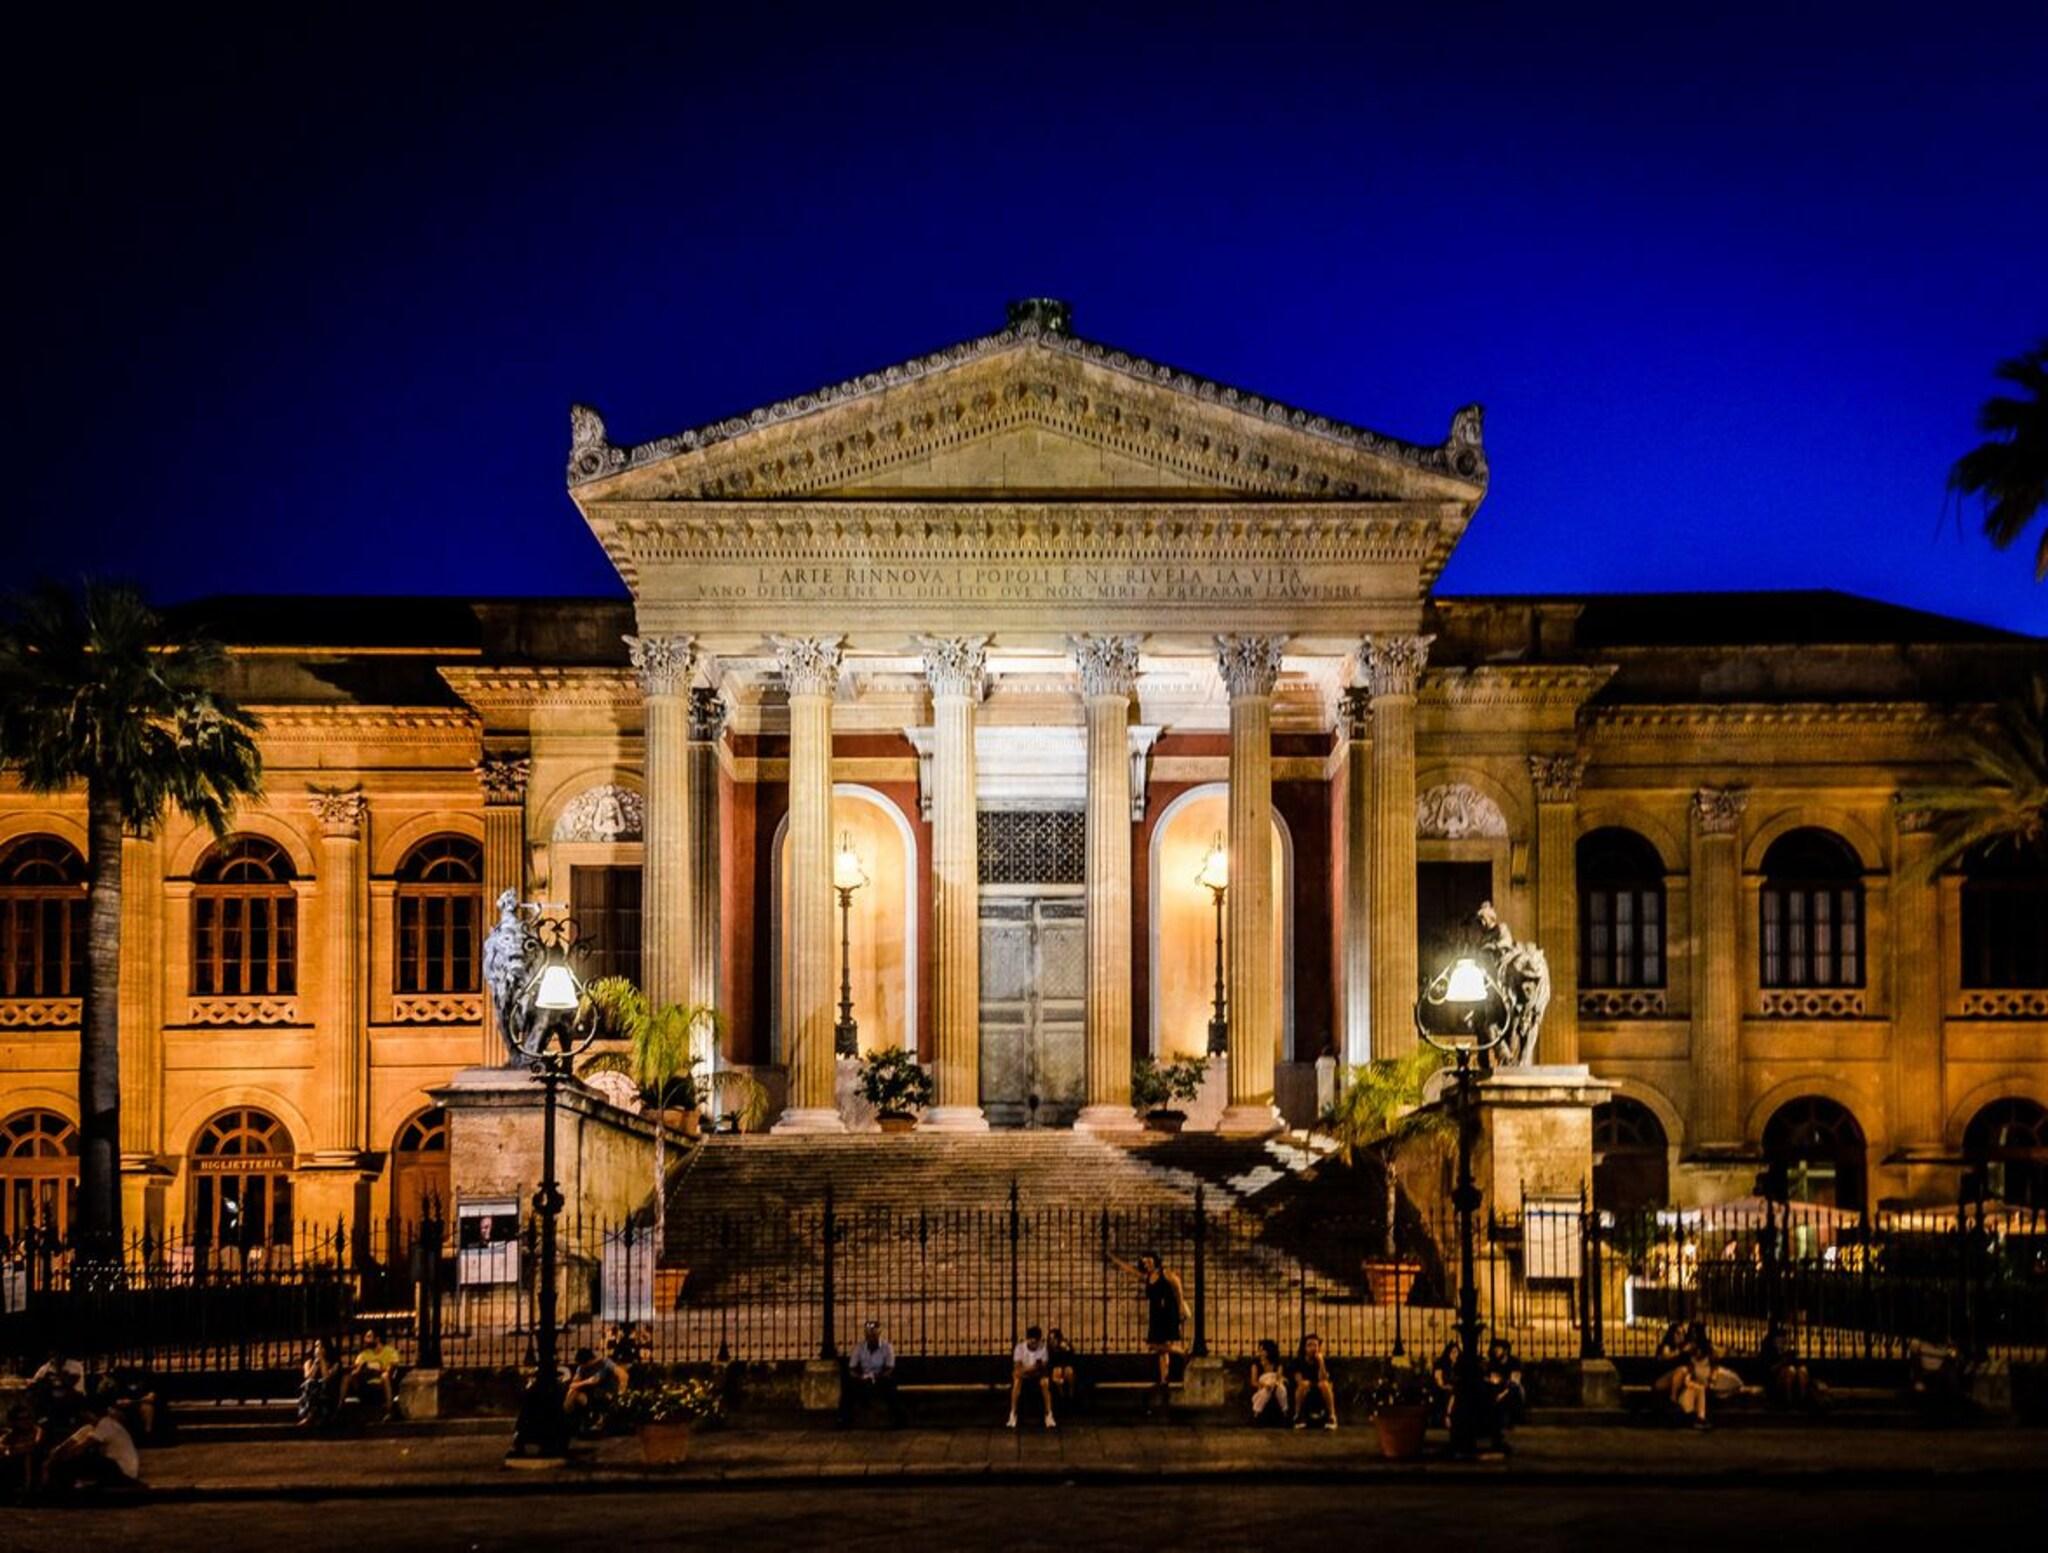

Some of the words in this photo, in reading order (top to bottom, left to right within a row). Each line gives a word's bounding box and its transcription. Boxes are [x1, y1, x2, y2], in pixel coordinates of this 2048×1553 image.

[846, 568, 943, 583] RINNOVA
[976, 568, 1049, 583] POPOLI
[1252, 568, 1301, 583] VITA
[698, 584, 746, 597] VANO
[1046, 584, 1082, 597] NON
[201, 1160, 283, 1169] BIGLIETTERIA
